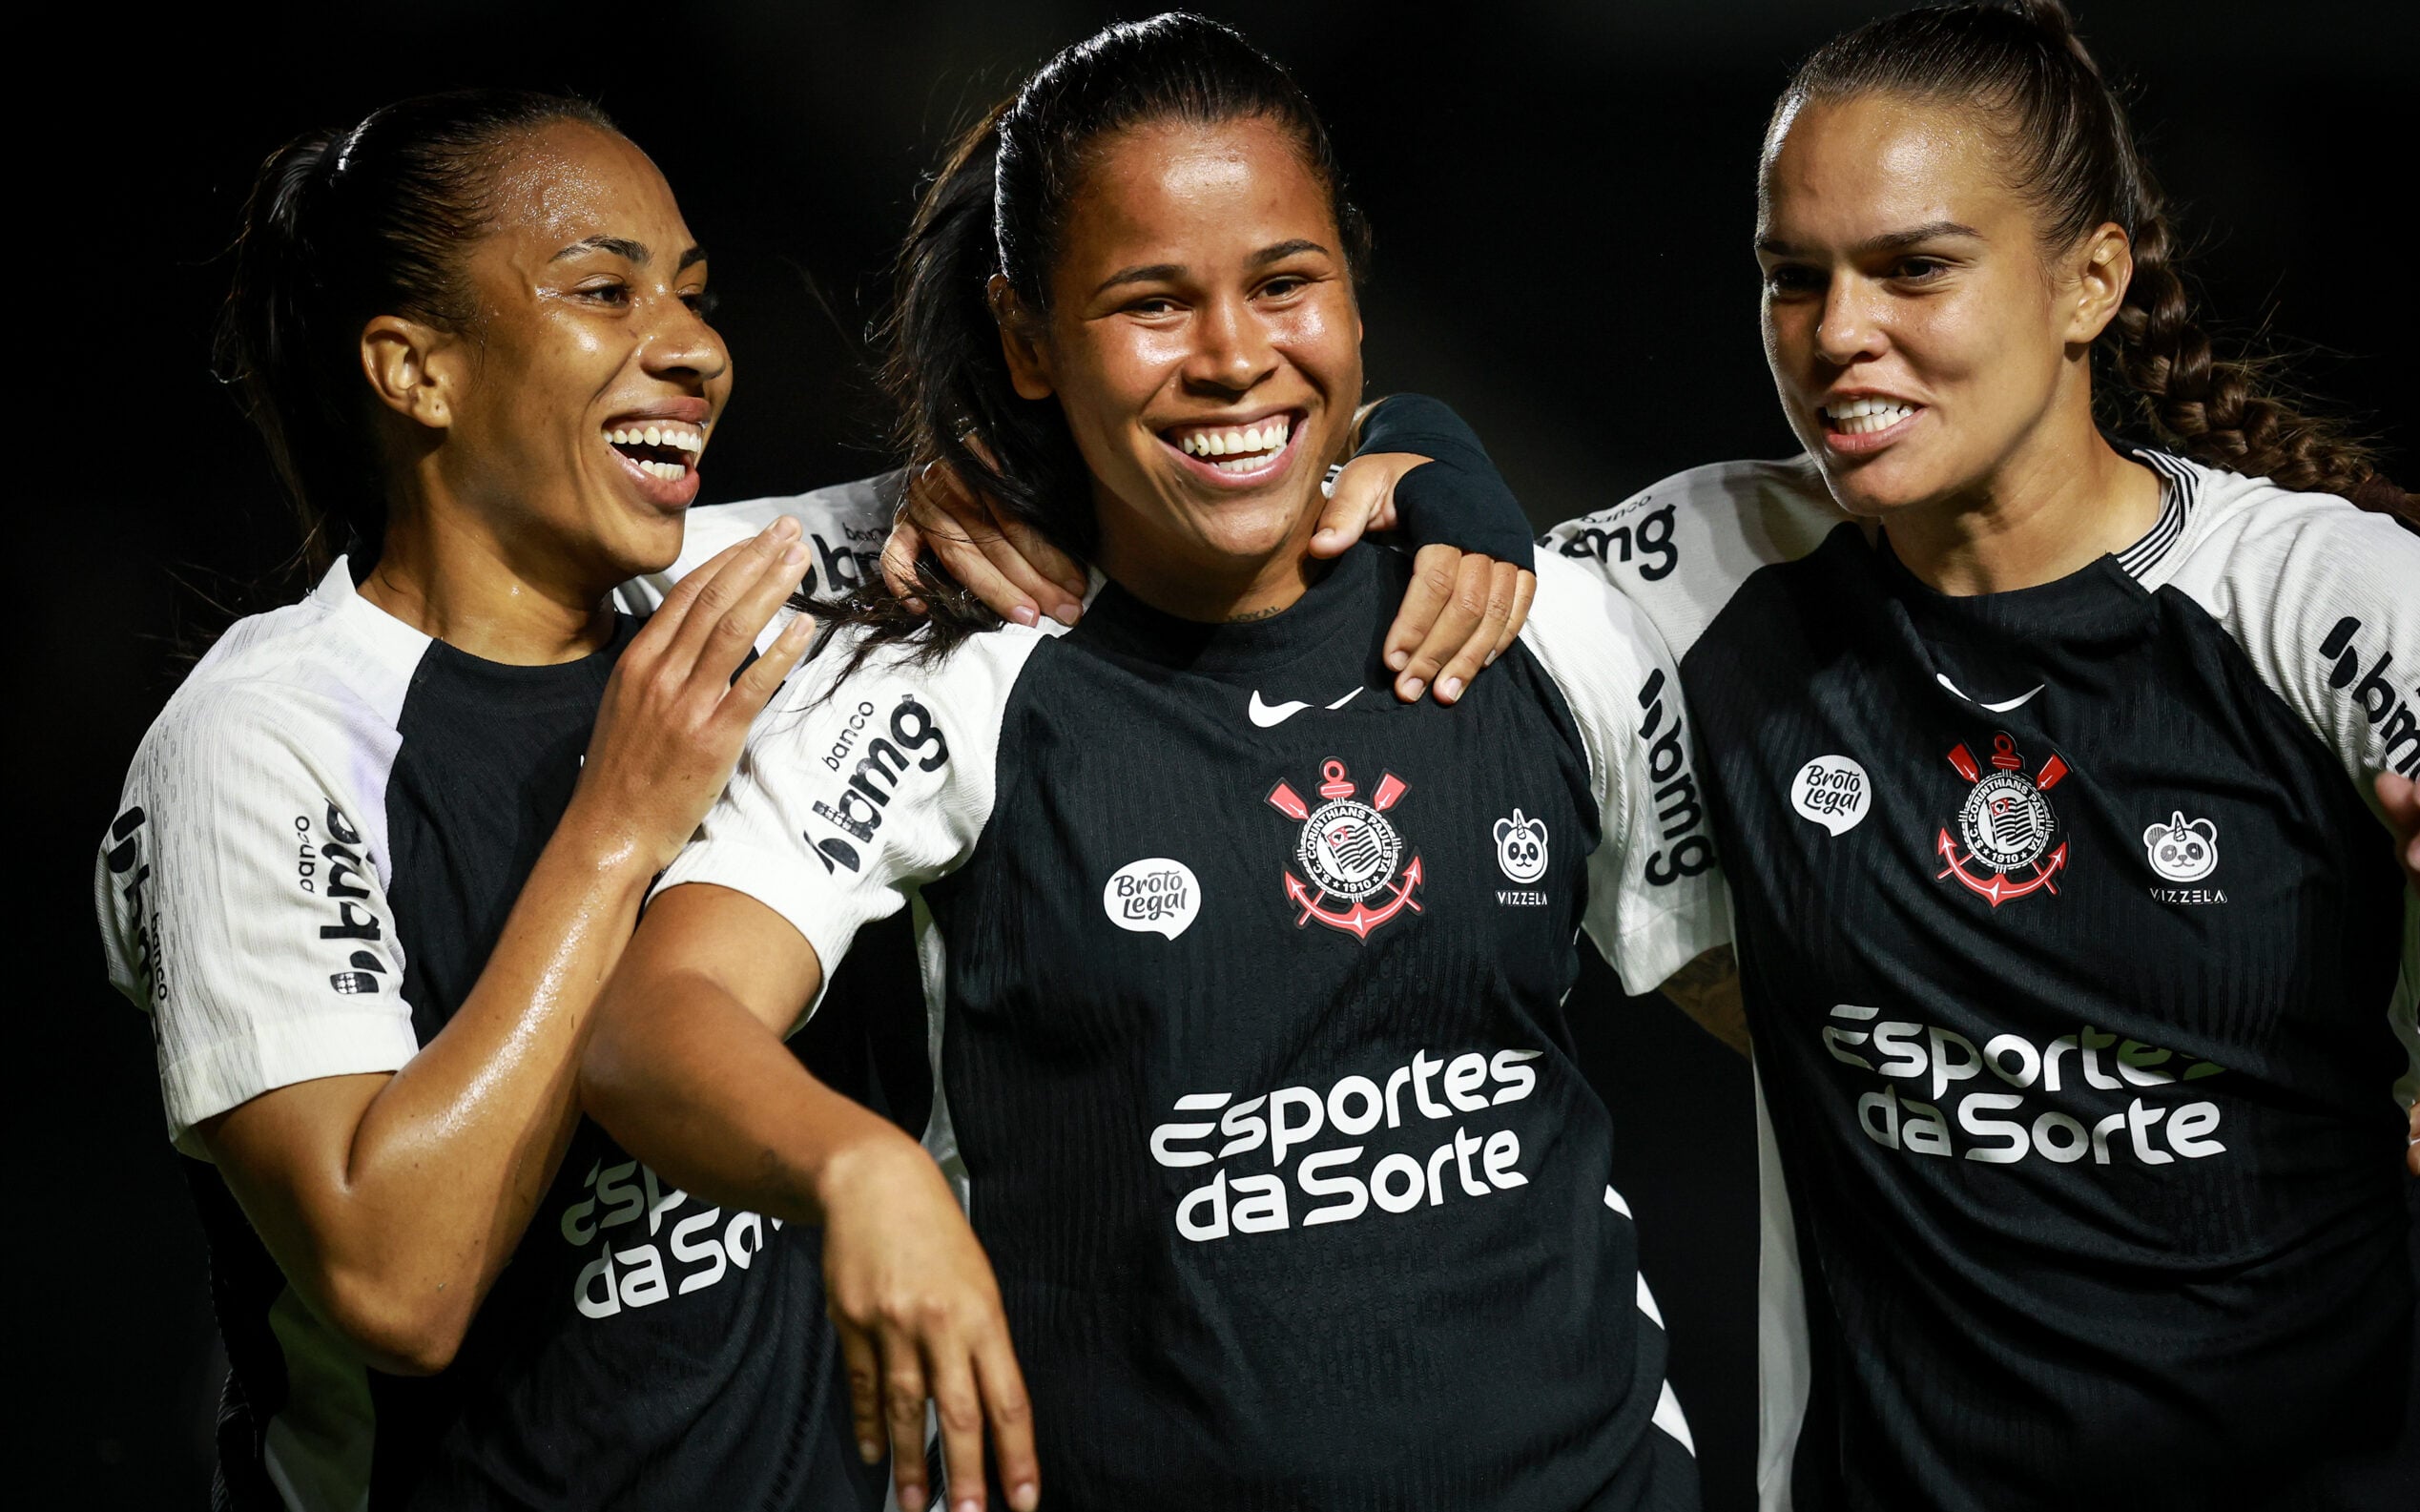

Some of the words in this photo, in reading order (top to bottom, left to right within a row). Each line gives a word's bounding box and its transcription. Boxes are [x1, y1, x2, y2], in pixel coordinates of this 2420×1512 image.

[842, 522, 885, 545] ban
[821, 701, 875, 772] banco
[2351, 651, 2420, 782] bm
[812, 694, 949, 843] bmg
[1644, 715, 1716, 886] bmg
[1804, 788, 1861, 817] Legal
[1807, 765, 1860, 792] Broto
[1307, 807, 1367, 860] CORINTHIANS
[1367, 817, 1392, 874] PAULISTA
[1968, 777, 2029, 822] CORINTHIANS
[2029, 794, 2046, 851] PAULISTA
[1113, 870, 1183, 898] Broto
[1342, 880, 1372, 893] 1910
[1992, 852, 2018, 863] 1910
[1124, 888, 1188, 921] Legal
[1497, 891, 1547, 905] VIZZELA
[2149, 887, 2226, 903] VIZZELA
[151, 912, 168, 1001] banco
[1149, 1048, 1543, 1168] Esportes
[1858, 1084, 1952, 1157] da
[1957, 1092, 2227, 1165] Sorte
[1175, 1168, 1290, 1242] da
[1297, 1126, 1529, 1227] Sorte
[573, 1240, 670, 1319] da
